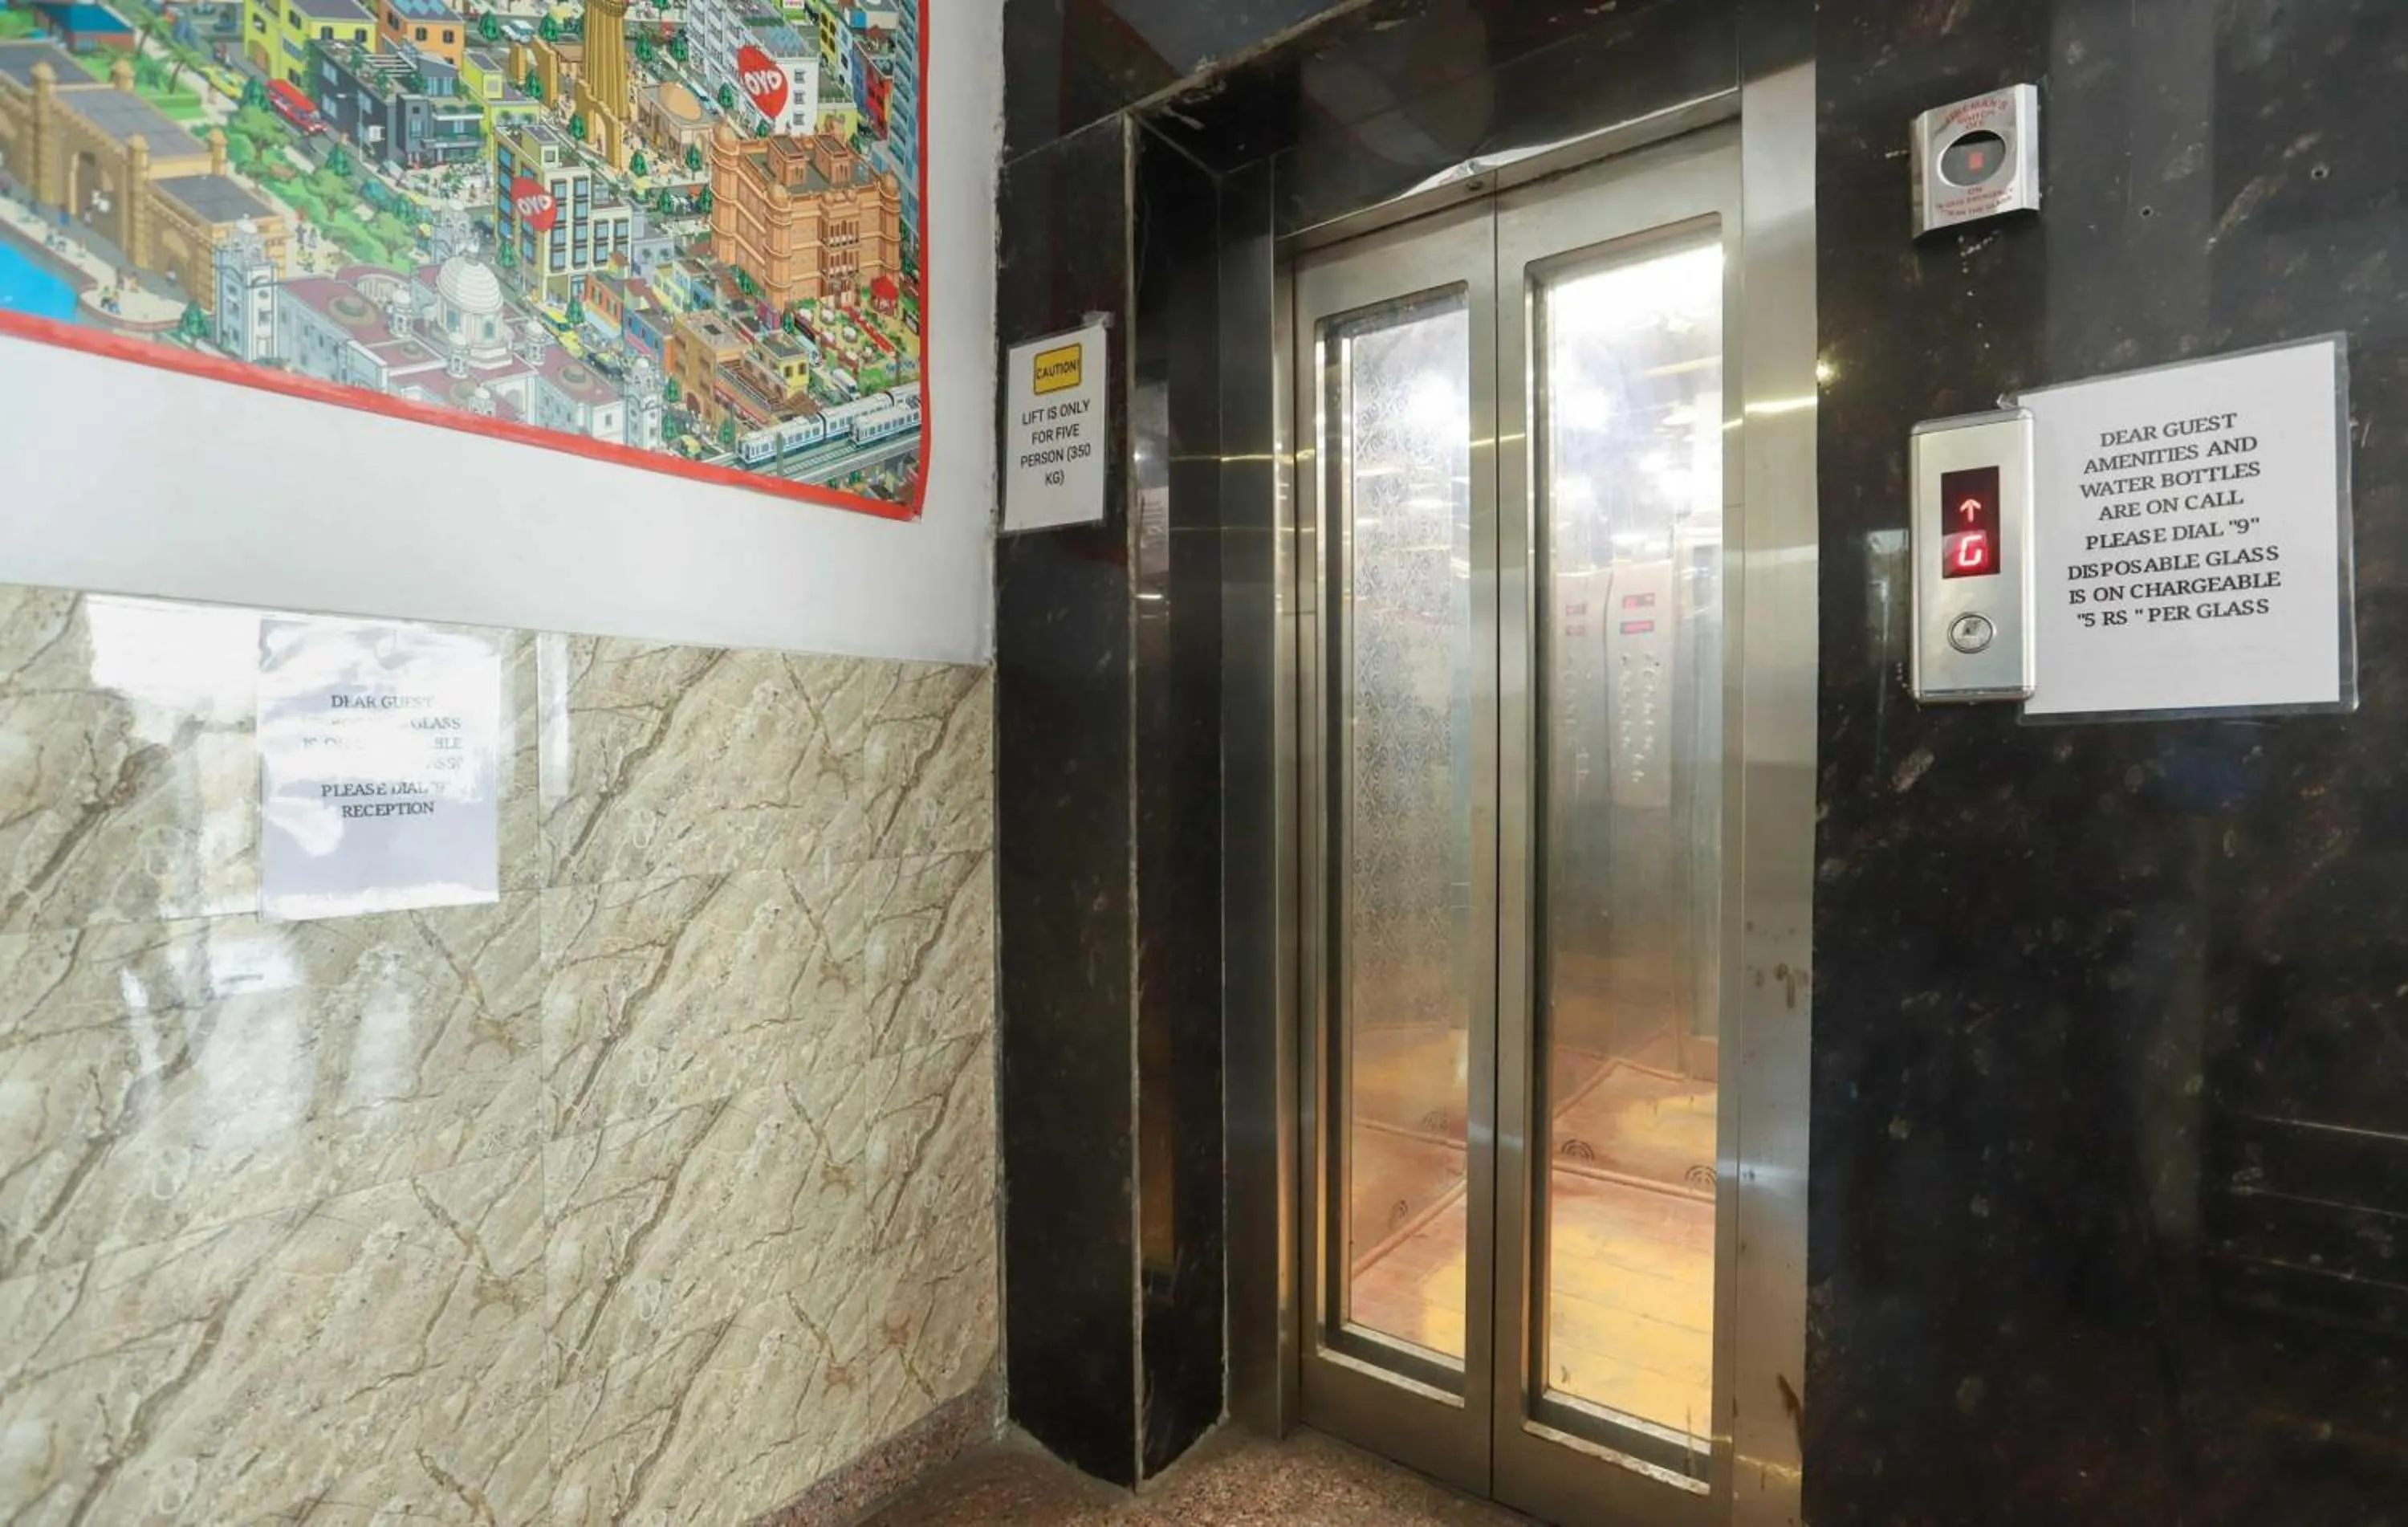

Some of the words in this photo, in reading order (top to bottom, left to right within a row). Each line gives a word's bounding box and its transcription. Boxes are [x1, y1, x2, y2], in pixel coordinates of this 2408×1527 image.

[745, 70, 783, 96] OYO
[517, 194, 552, 216] OYO
[1022, 409, 1045, 426] LIFT
[1047, 405, 1058, 421] IS
[1060, 398, 1091, 417] ONLY
[1031, 430, 1053, 445] FOR
[1056, 423, 1080, 439] FIVE
[2101, 426, 2158, 447] DEAR
[2163, 413, 2237, 438] GUEST
[1020, 448, 1064, 468] PERSON
[1067, 443, 1092, 464] (350
[2084, 444, 2199, 474] AMENITIES
[2207, 436, 2258, 458] AND
[1044, 469, 1065, 487] KG)
[2080, 475, 2155, 499] WATER
[2161, 461, 2261, 488] BOTTLES
[2098, 502, 2142, 521] ARE
[2146, 497, 2179, 515] ON
[2185, 490, 2244, 511] CALL
[2086, 527, 2167, 550] PLEASE
[2172, 522, 2224, 542] DIAL
[2229, 517, 2260, 534] "9"
[1959, 534, 1983, 566] G
[2068, 553, 2200, 580] DISPOSABLE
[2206, 545, 2280, 567] GLASS
[2068, 588, 2086, 605] IS
[2093, 585, 2125, 602] ON
[2129, 571, 2281, 599] CHARGEABLE
[2077, 612, 2096, 628] "5
[2102, 609, 2128, 626] RS
[2148, 605, 2190, 622] PER
[2196, 598, 2270, 620] GLASS
[332, 694, 376, 708] DEAR
[410, 717, 462, 730] GLASS
[321, 782, 387, 797] PLEASE
[342, 800, 435, 818] RECEPTION
